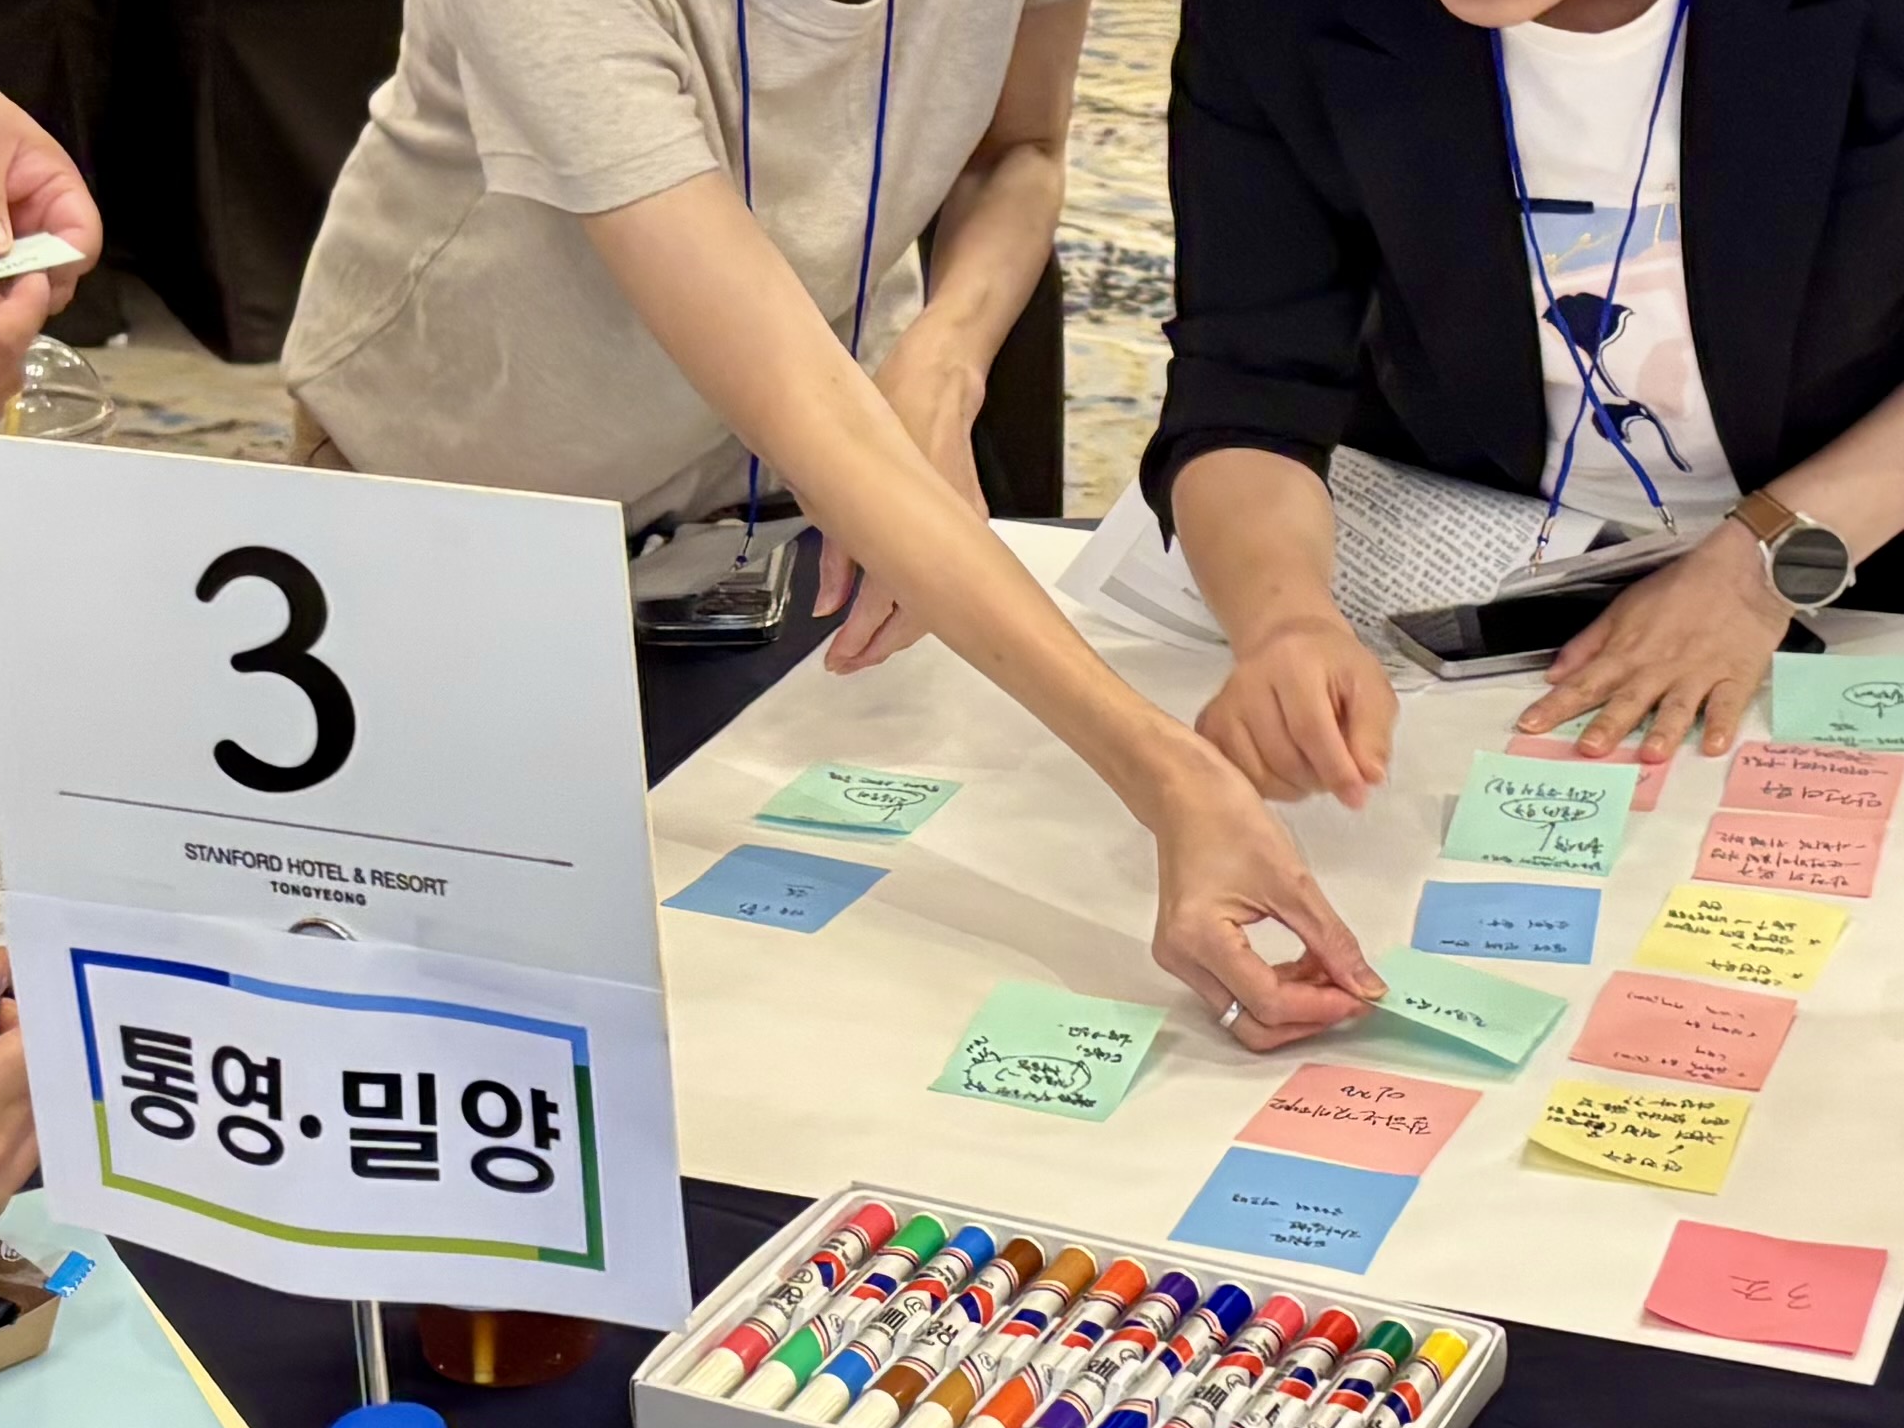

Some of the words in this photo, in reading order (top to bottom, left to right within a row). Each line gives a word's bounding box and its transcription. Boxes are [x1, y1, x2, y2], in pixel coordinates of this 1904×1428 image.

[196, 545, 356, 793] 3
[184, 842, 282, 875] STANFORD
[286, 856, 350, 884] HOTEL
[353, 866, 367, 885] &
[371, 869, 449, 897] RESORT
[270, 881, 368, 908] TONGYEONG
[118, 1024, 561, 1195] 통영·밀양
